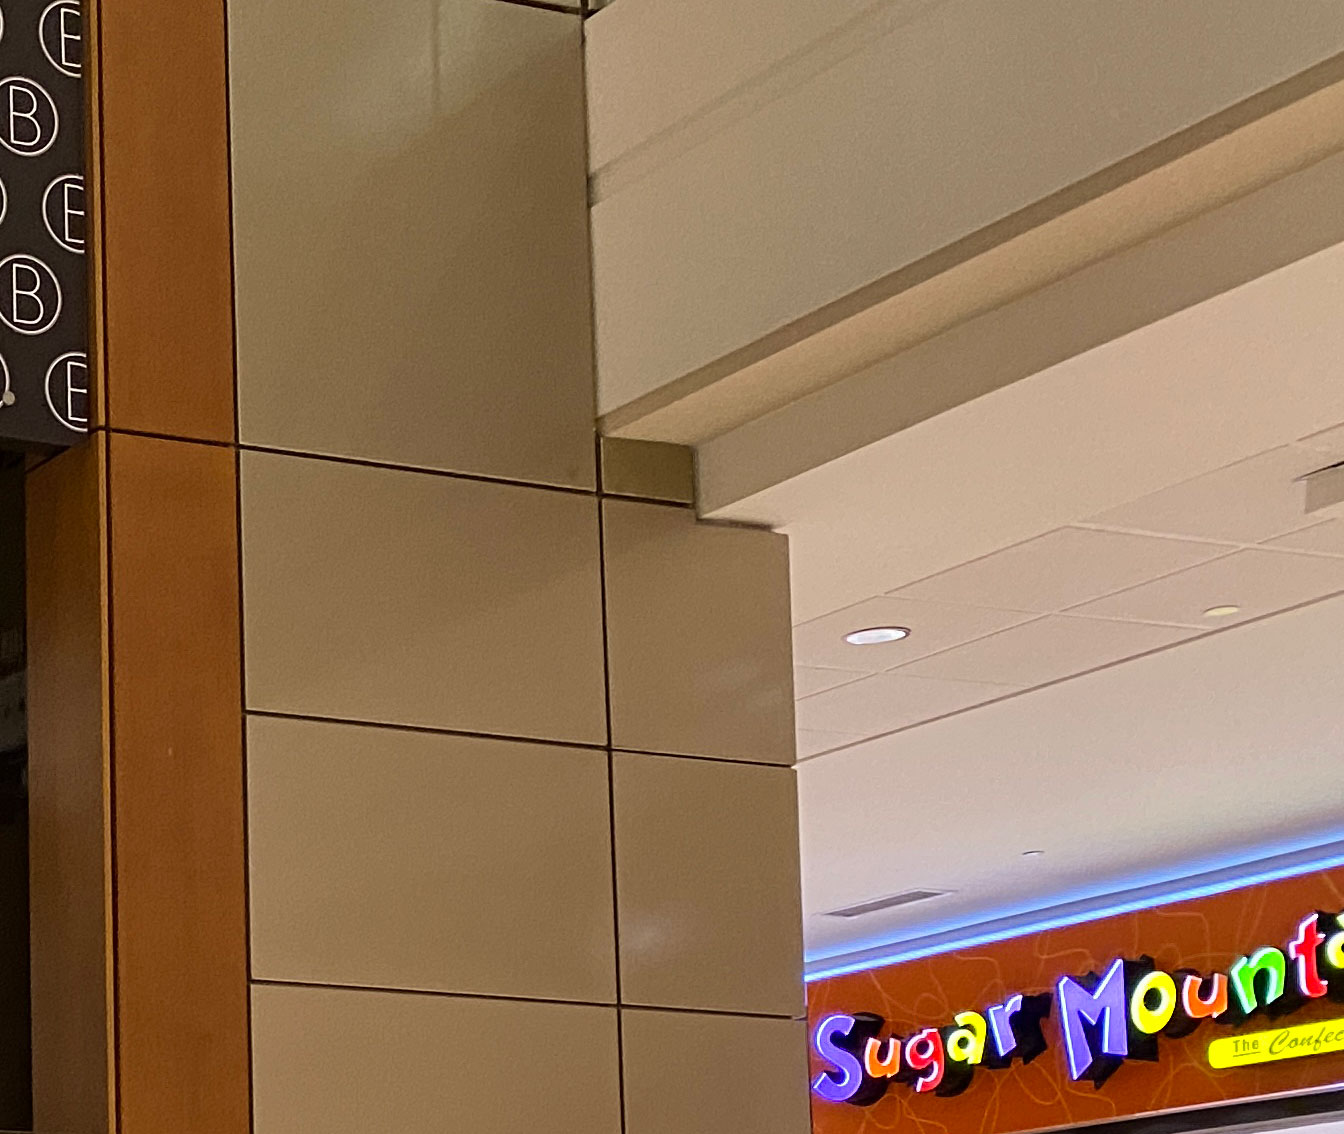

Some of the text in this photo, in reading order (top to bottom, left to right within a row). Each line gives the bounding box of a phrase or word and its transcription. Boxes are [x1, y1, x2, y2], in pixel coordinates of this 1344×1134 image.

[8, 83, 41, 147] B
[10, 262, 44, 326] B
[812, 994, 1023, 1102] Sugar
[1233, 1039, 1260, 1053] The
